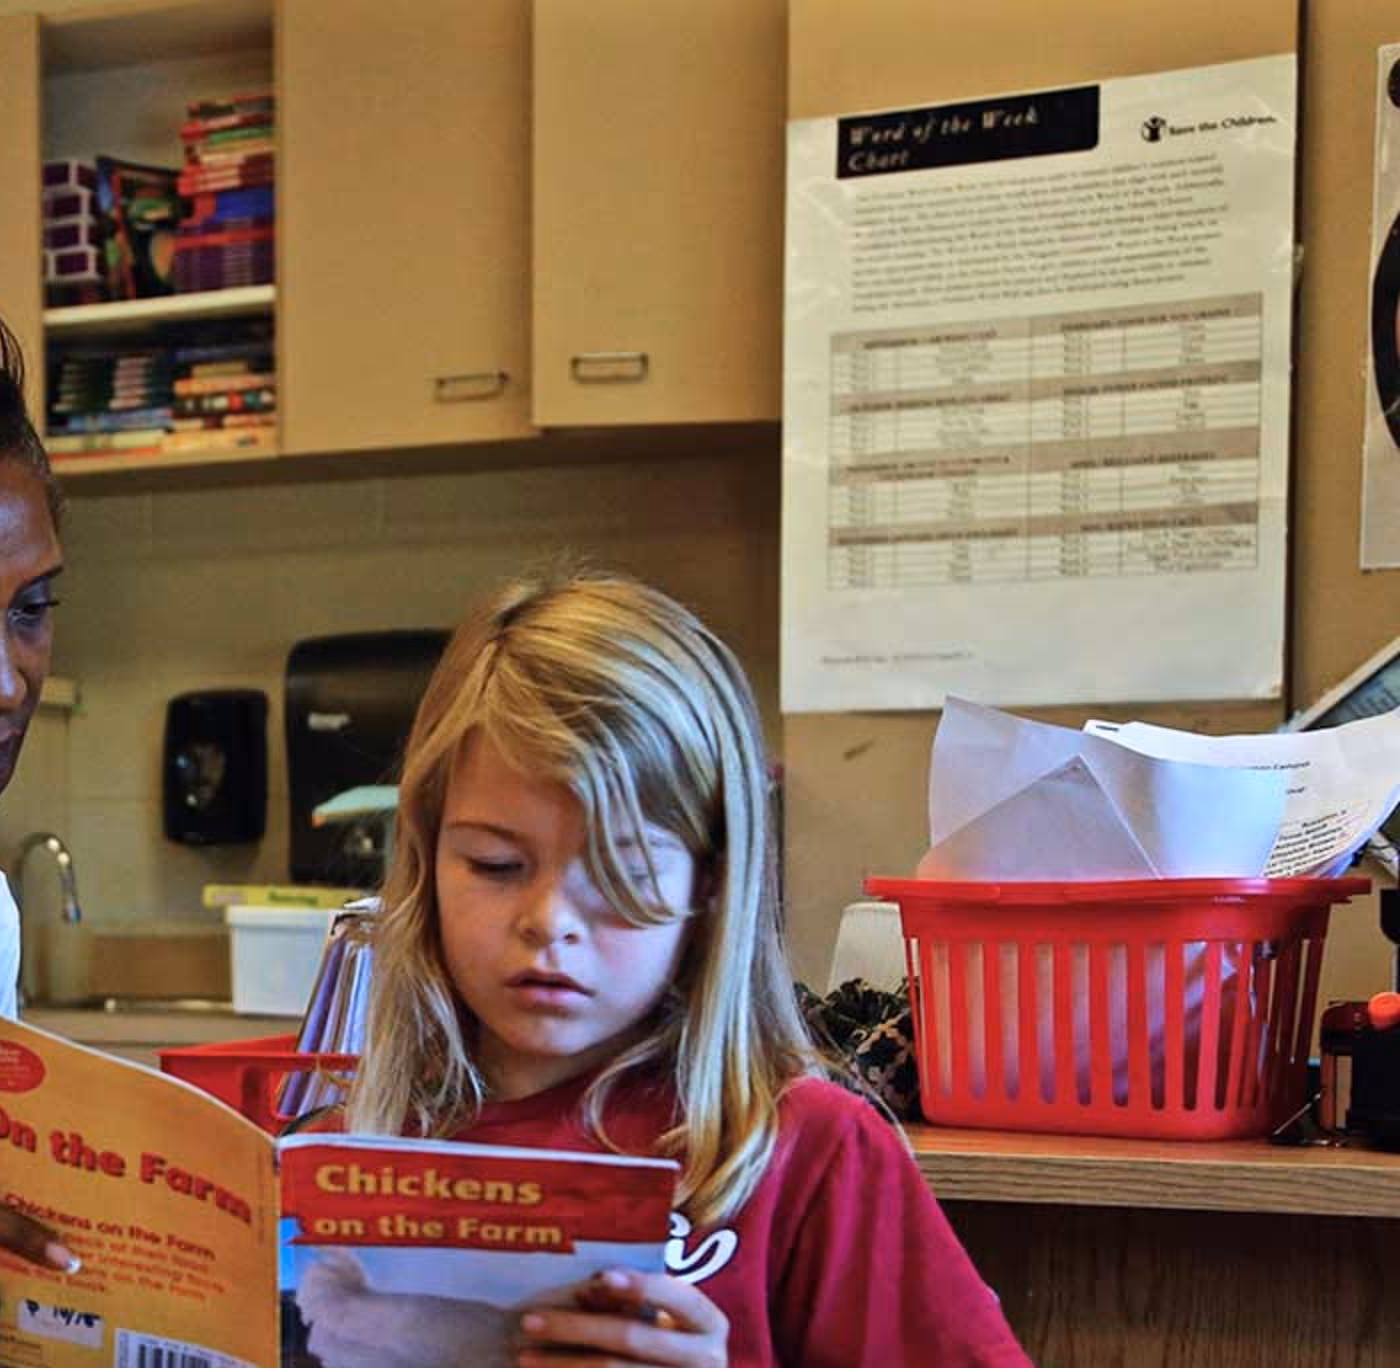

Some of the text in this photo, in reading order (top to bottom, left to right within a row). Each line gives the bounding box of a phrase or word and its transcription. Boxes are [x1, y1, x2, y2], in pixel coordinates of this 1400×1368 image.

[850, 104, 1039, 145] Word of the Week
[848, 149, 910, 172] Chart
[49, 1129, 127, 1178] the
[140, 1151, 253, 1227] Farm
[316, 1163, 542, 1205] Chickens
[6, 1192, 92, 1231] Chickens
[97, 1216, 123, 1237] on
[129, 1224, 162, 1245] the
[315, 1214, 563, 1246] on the Farm
